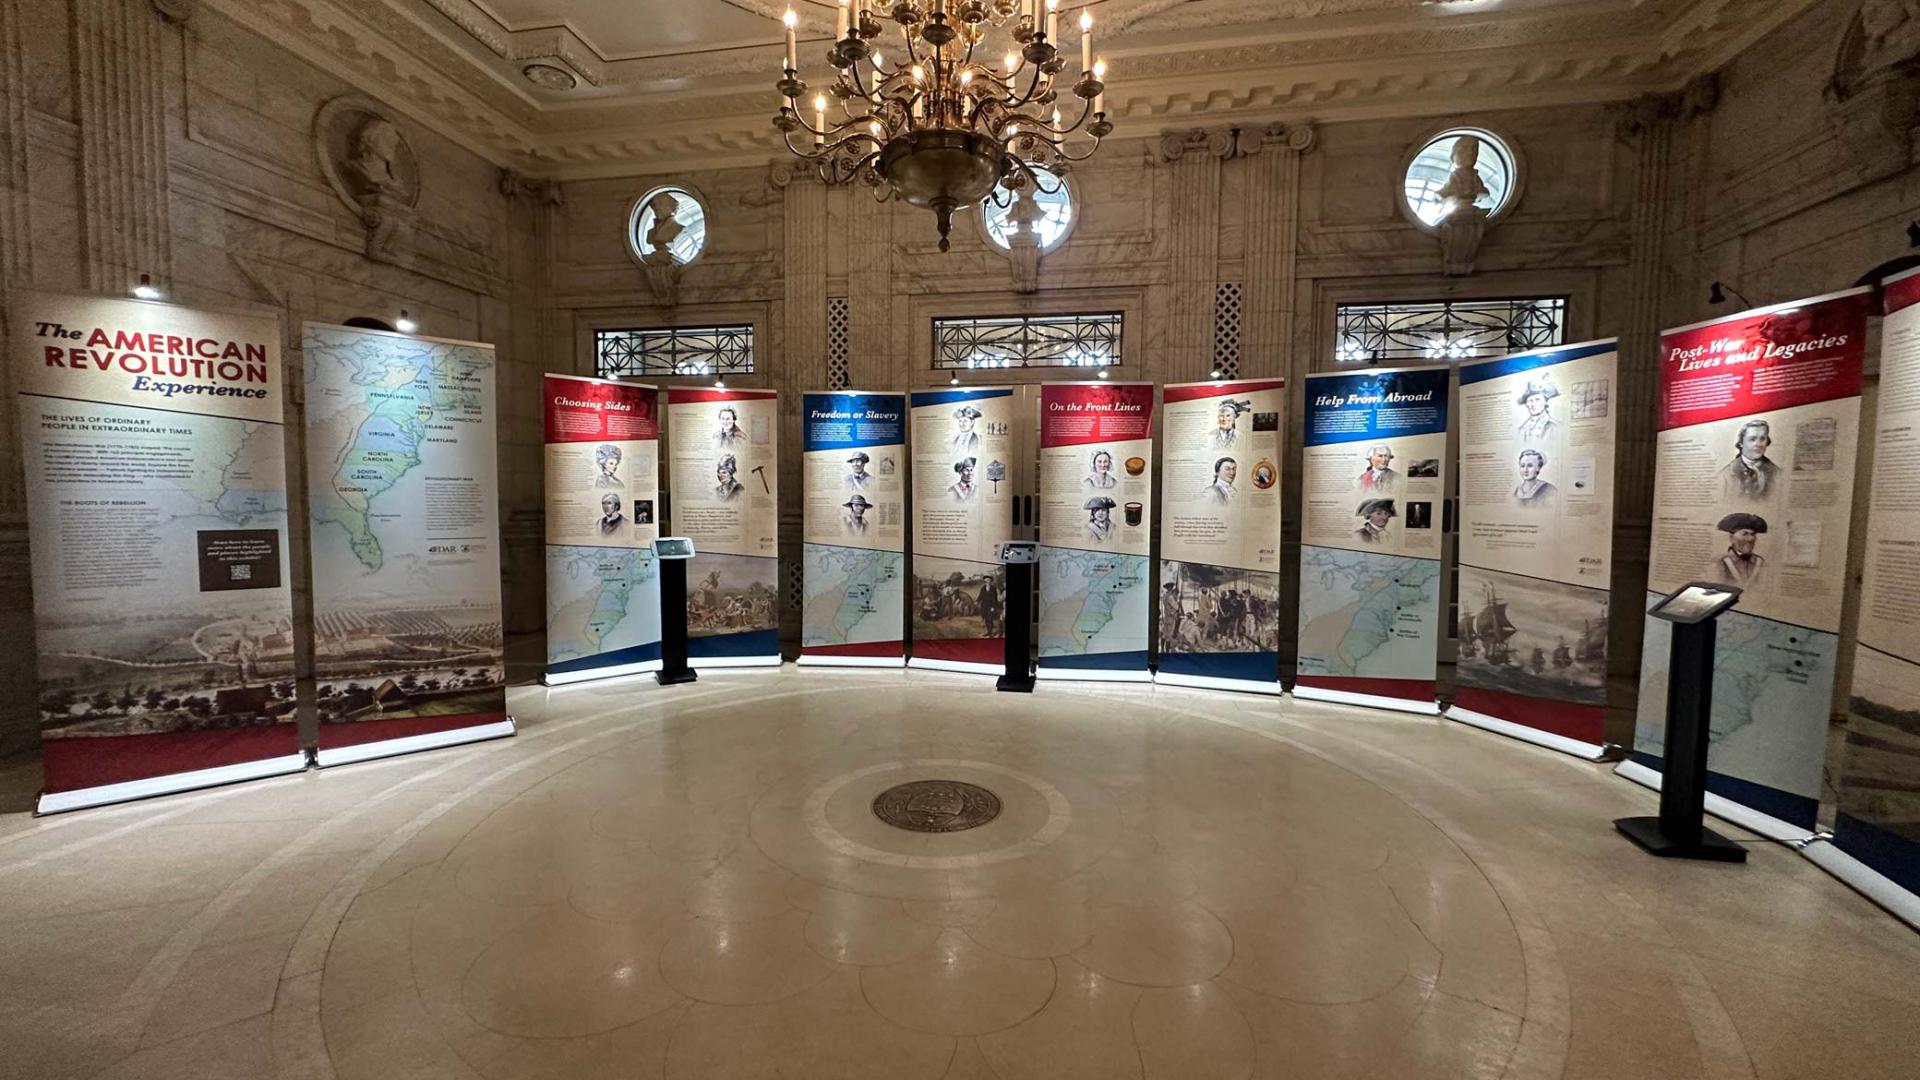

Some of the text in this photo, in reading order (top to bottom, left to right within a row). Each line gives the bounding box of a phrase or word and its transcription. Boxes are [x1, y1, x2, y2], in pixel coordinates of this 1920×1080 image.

[36, 321, 267, 363] The AMERICAN
[1670, 338, 1746, 362] Post-War
[1678, 333, 1848, 372] Lives and Legacies
[44, 345, 267, 384] REVOLUTION
[132, 375, 267, 399] Experience
[554, 396, 631, 412] Choosing Sides
[1050, 402, 1142, 412] On the Front Lines
[1315, 390, 1432, 408] Help From Abroad
[104, 417, 151, 425] ORDINARY
[811, 410, 851, 419] Freedom
[866, 410, 899, 420] Slavery
[41, 422, 76, 430] PEOPLE
[92, 424, 166, 434] EXTRAORDINARY
